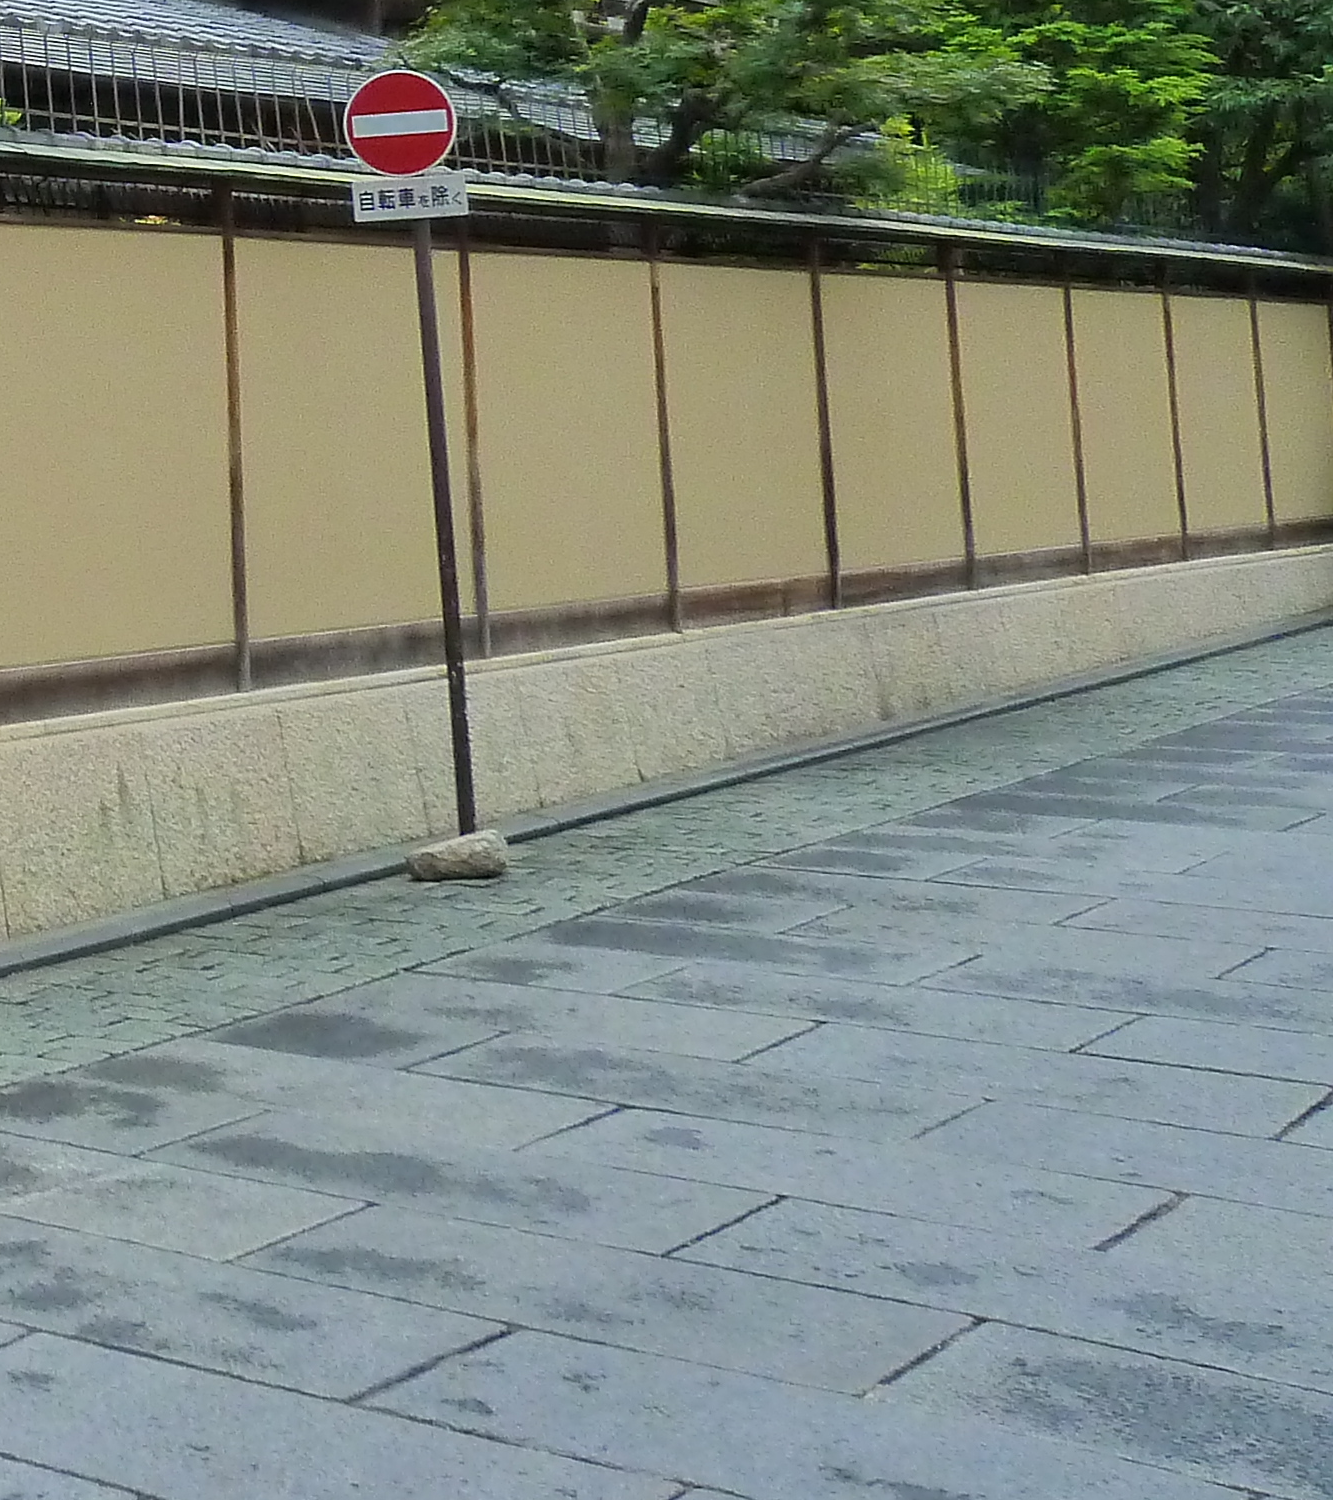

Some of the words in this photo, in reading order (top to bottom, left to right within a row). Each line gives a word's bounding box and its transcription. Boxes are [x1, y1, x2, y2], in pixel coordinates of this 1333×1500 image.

[359, 185, 462, 211] 自転車を除く
